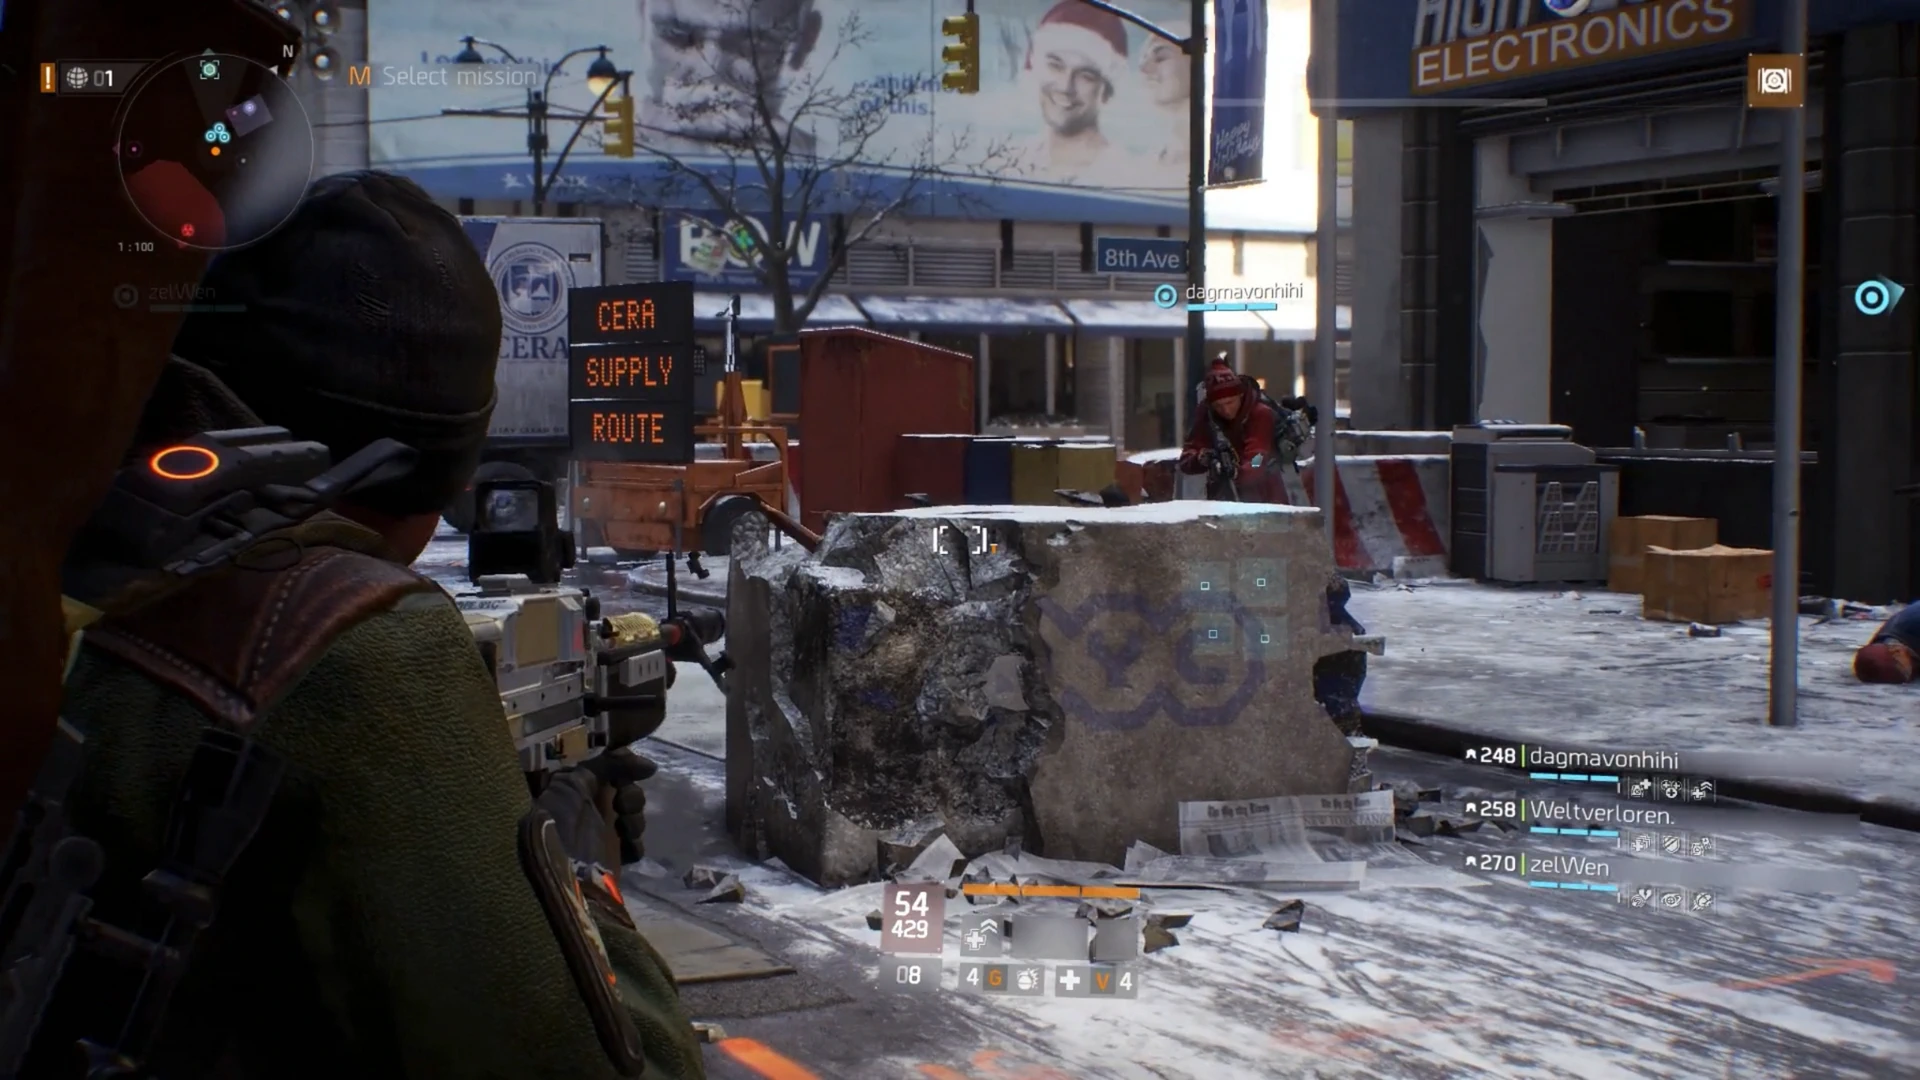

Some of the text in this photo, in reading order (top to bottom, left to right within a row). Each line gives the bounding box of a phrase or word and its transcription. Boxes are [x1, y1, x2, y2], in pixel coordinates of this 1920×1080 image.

[1417, 0, 1734, 87] ELECTRONICS
[1105, 249, 1180, 268] 8th Ave
[598, 299, 655, 331] CERA
[500, 335, 569, 360] CERA
[586, 355, 673, 387] SUPPLY
[593, 413, 665, 444] ROUTE
